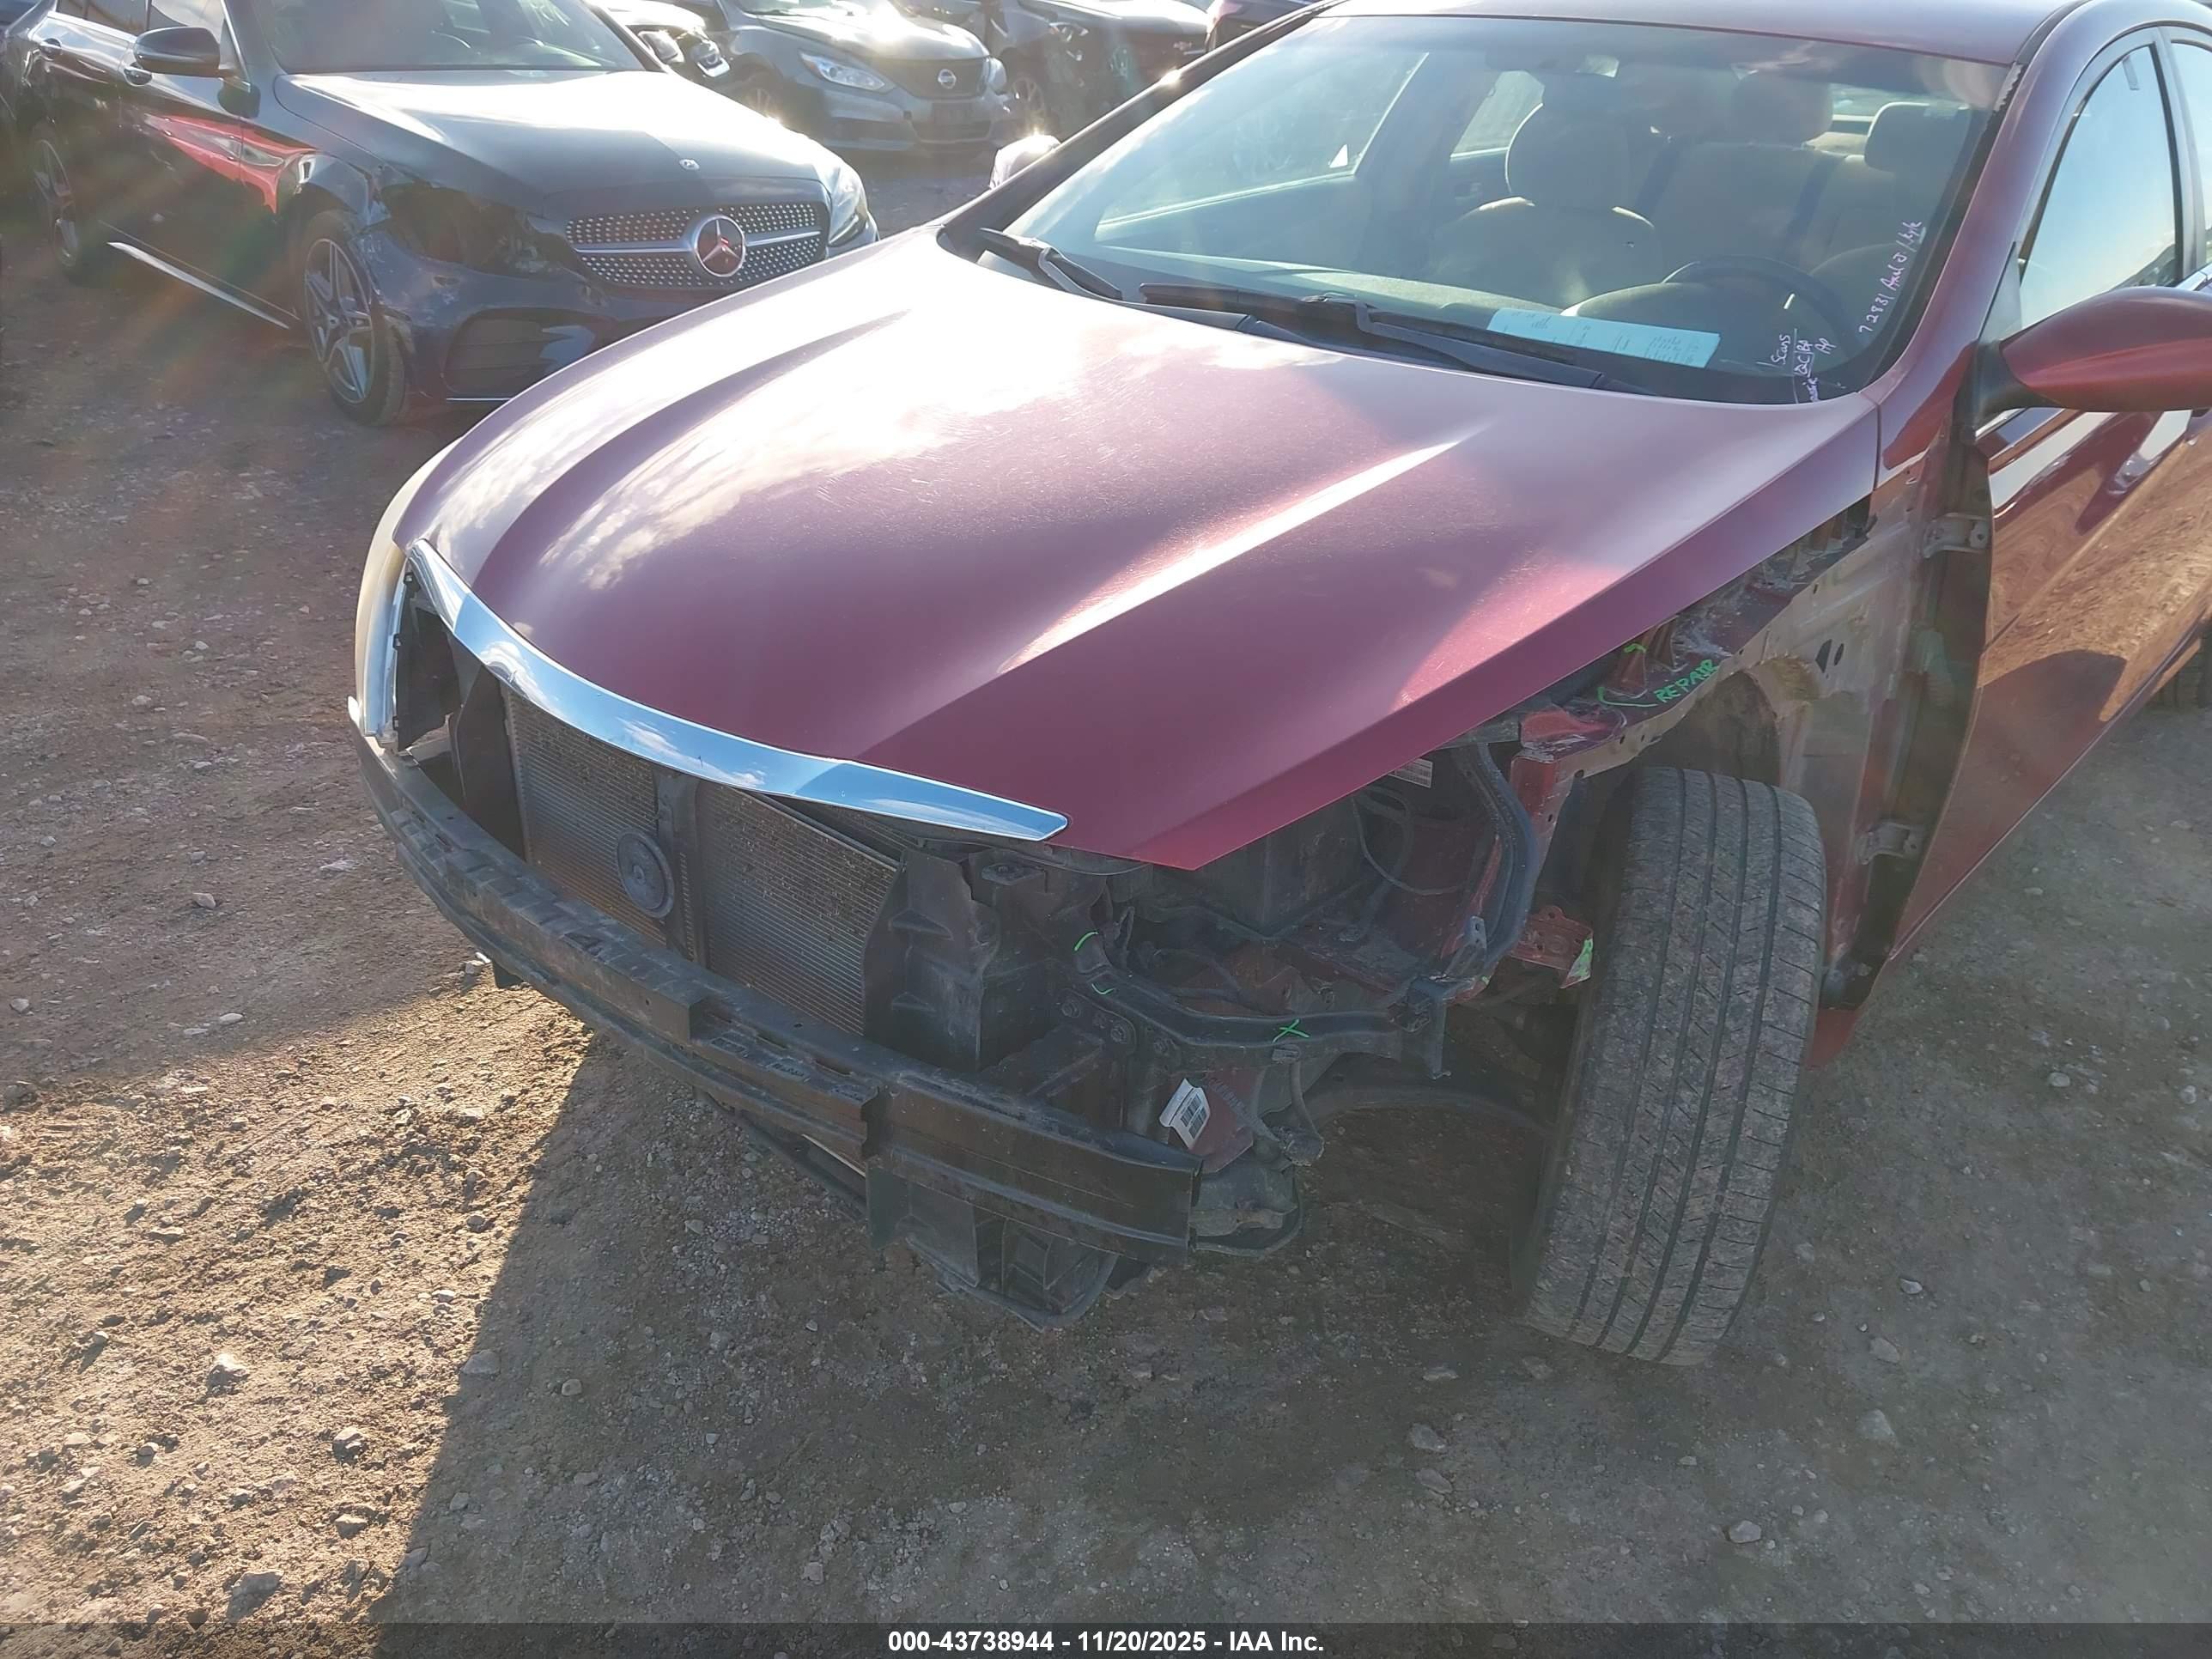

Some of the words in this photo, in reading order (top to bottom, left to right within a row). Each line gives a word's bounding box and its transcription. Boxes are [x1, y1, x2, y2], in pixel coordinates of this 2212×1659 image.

[1858, 293, 1895, 332] 72831
[1771, 334, 1791, 365] Scans
[1653, 659, 1720, 702] REPAIR
